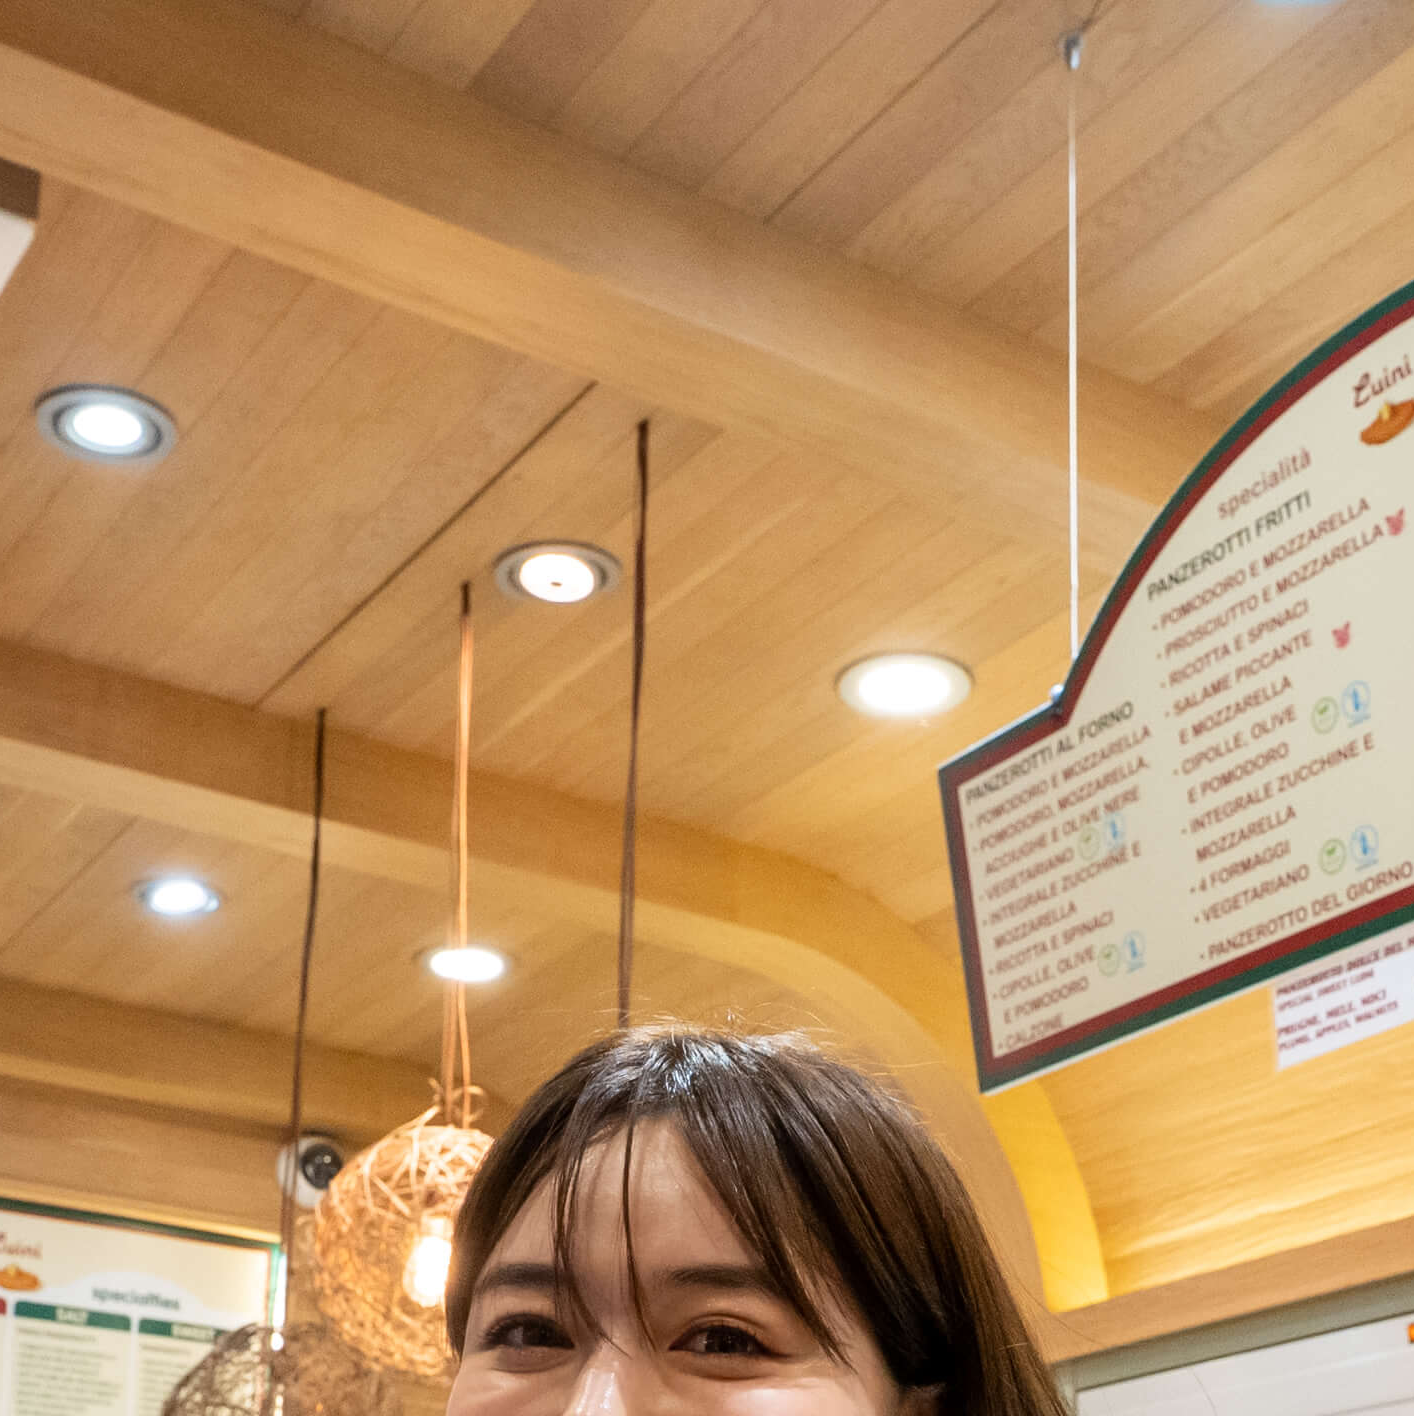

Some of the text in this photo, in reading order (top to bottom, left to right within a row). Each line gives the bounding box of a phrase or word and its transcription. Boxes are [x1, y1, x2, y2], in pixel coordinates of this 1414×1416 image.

[1218, 447, 1312, 520] specialità
[1146, 489, 1311, 601] PANZEROTTI FRITTI
[1160, 494, 1370, 628] POMODORO E MOZZARELLA
[1164, 521, 1384, 658] PROSCIUTTO E MOZZARELLA
[1169, 597, 1309, 687] RICOTTA E SPINACI
[1173, 629, 1313, 716] SALAME PICCANTE
[965, 700, 1134, 804] PANZEROTTI AL FORNO
[1178, 672, 1293, 745] E MOZZARELLA
[1250, 703, 1296, 740] OLIVE
[1187, 740, 1289, 804] E POMODORO
[1190, 732, 1373, 835] INTEGRALE ZUCCHINE E
[1195, 802, 1296, 863] MOZZARELLA
[1203, 862, 1310, 923] VEGETARIANO
[1208, 859, 1413, 960] PANZEROTTO DEL GIORNO
